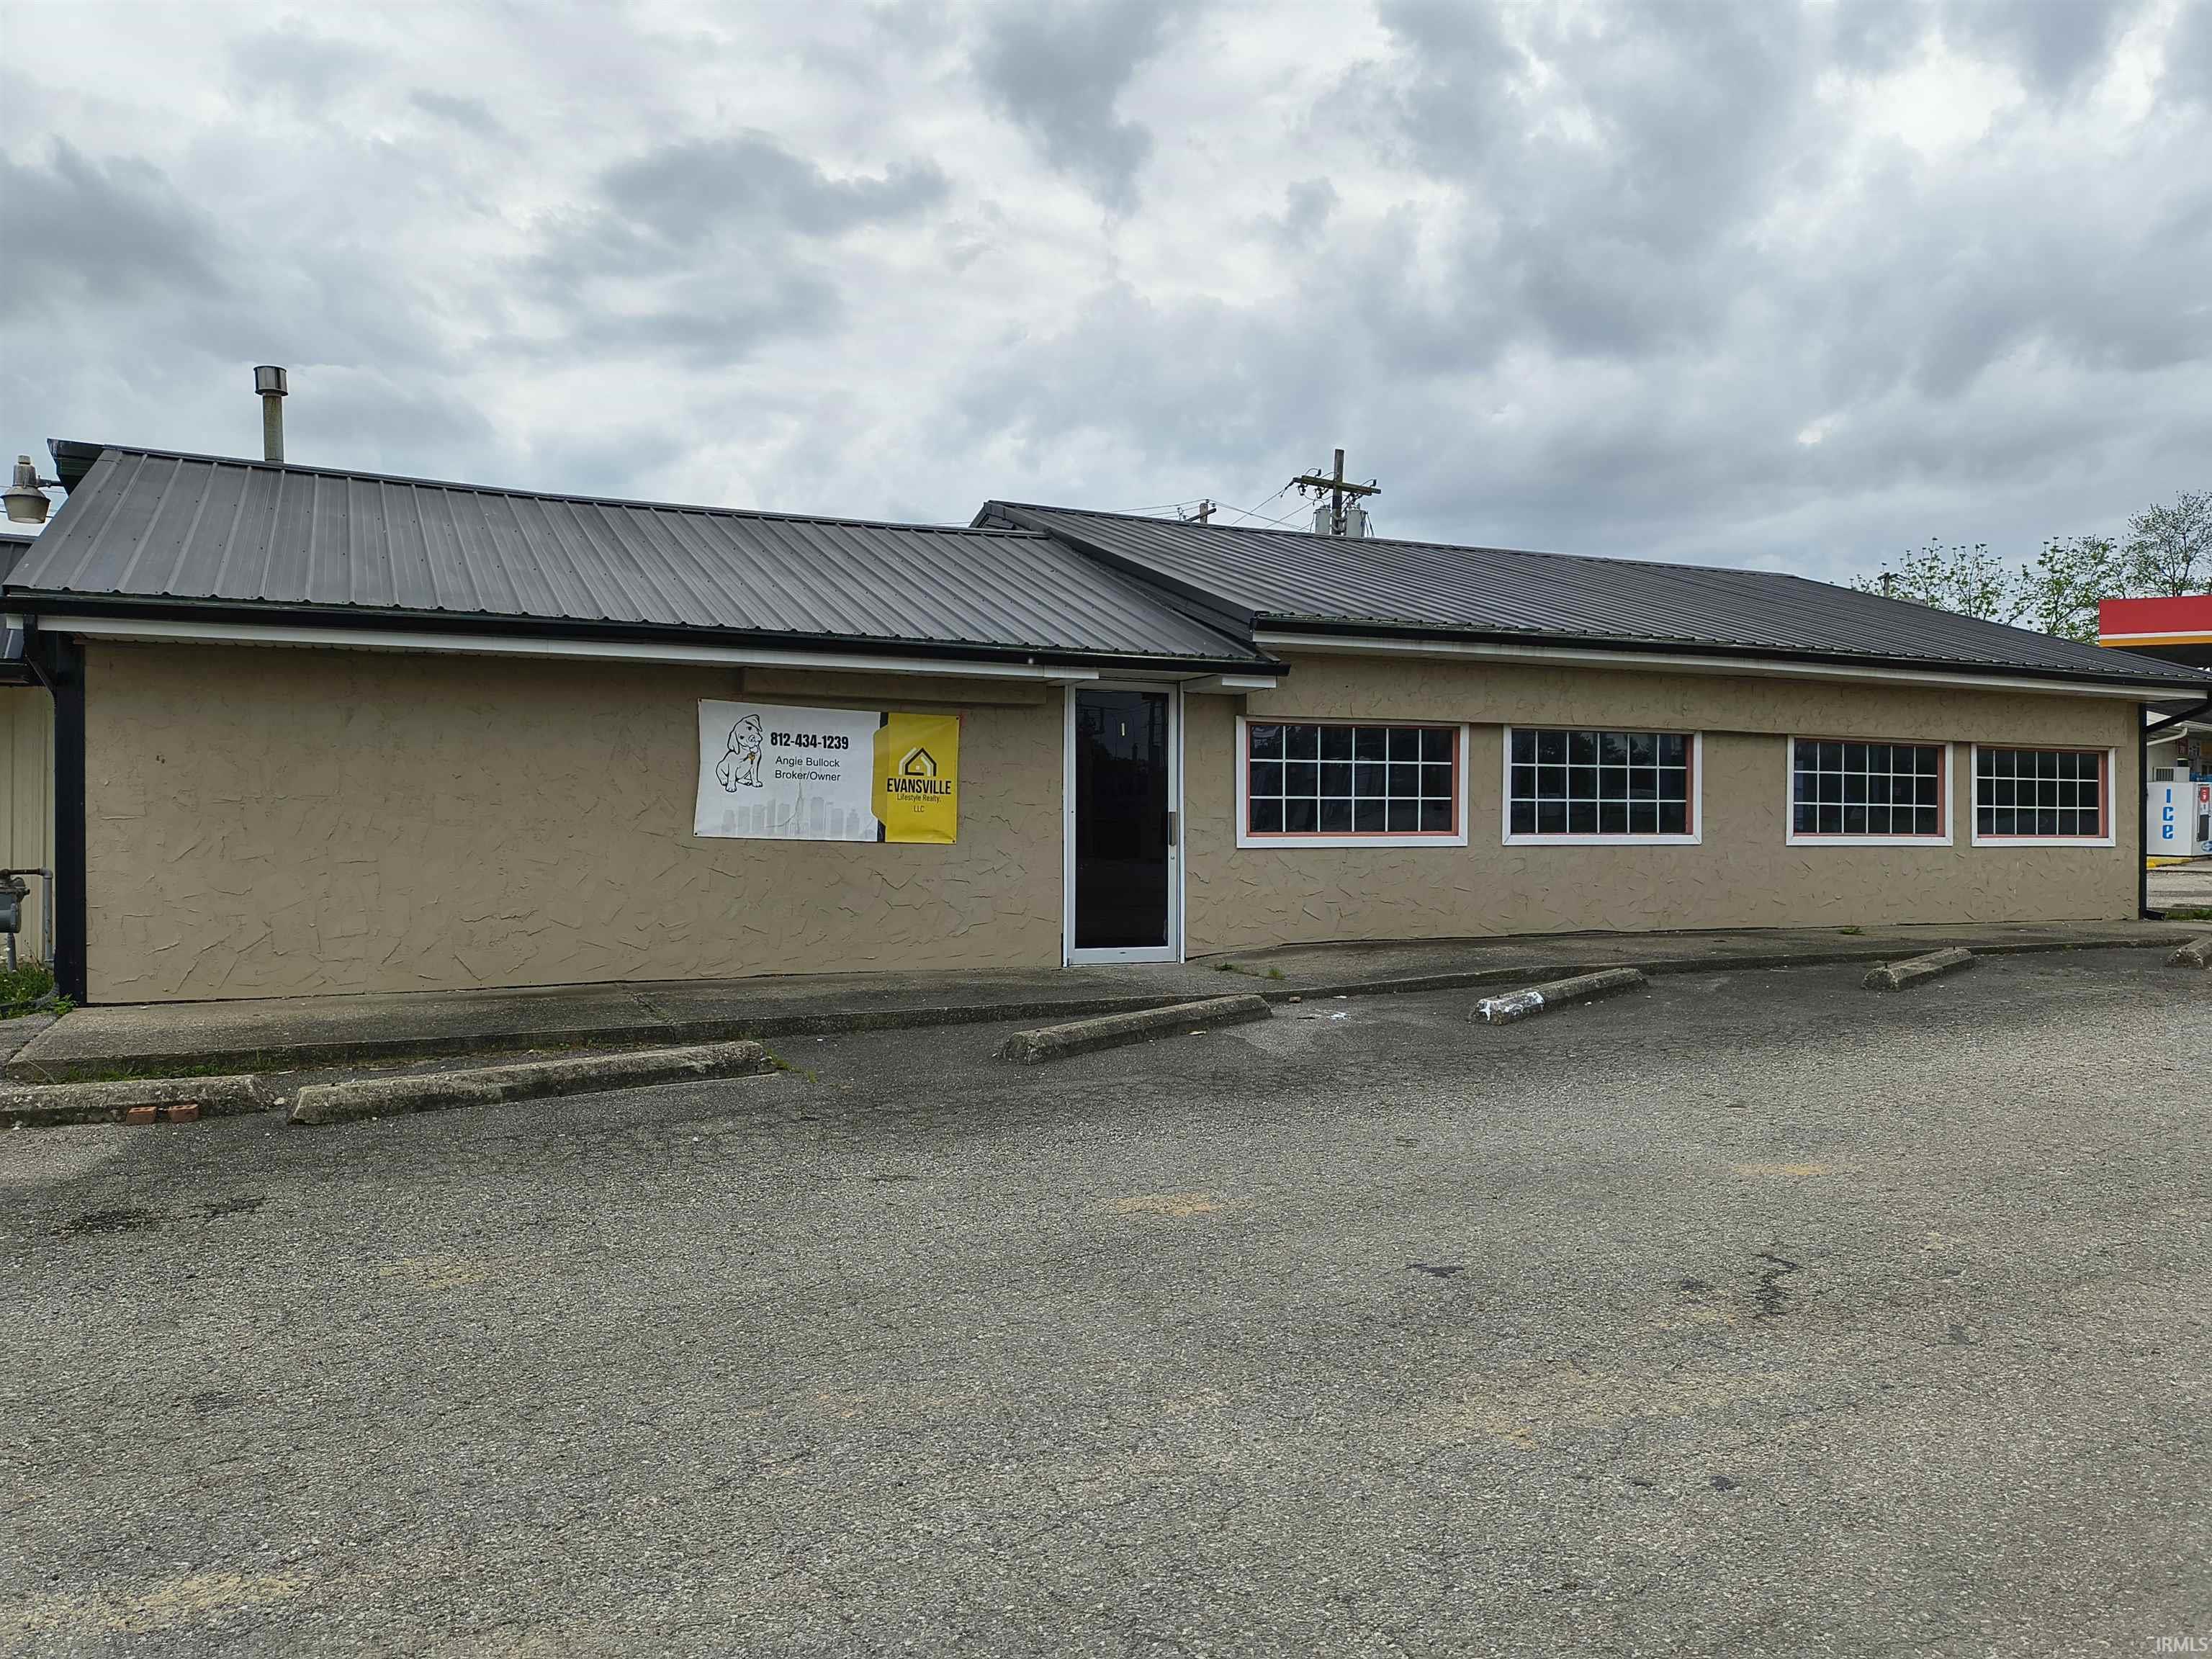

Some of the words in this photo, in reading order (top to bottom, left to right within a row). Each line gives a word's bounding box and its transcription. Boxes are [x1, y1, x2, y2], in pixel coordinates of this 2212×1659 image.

[770, 732, 849, 750] 812-434-1239
[775, 756, 803, 767] Angie
[806, 757, 840, 767] Bullock
[775, 770, 841, 781] Broker/Owner
[887, 778, 951, 794] EVANSVILLE
[897, 793, 921, 802] Lifestyle
